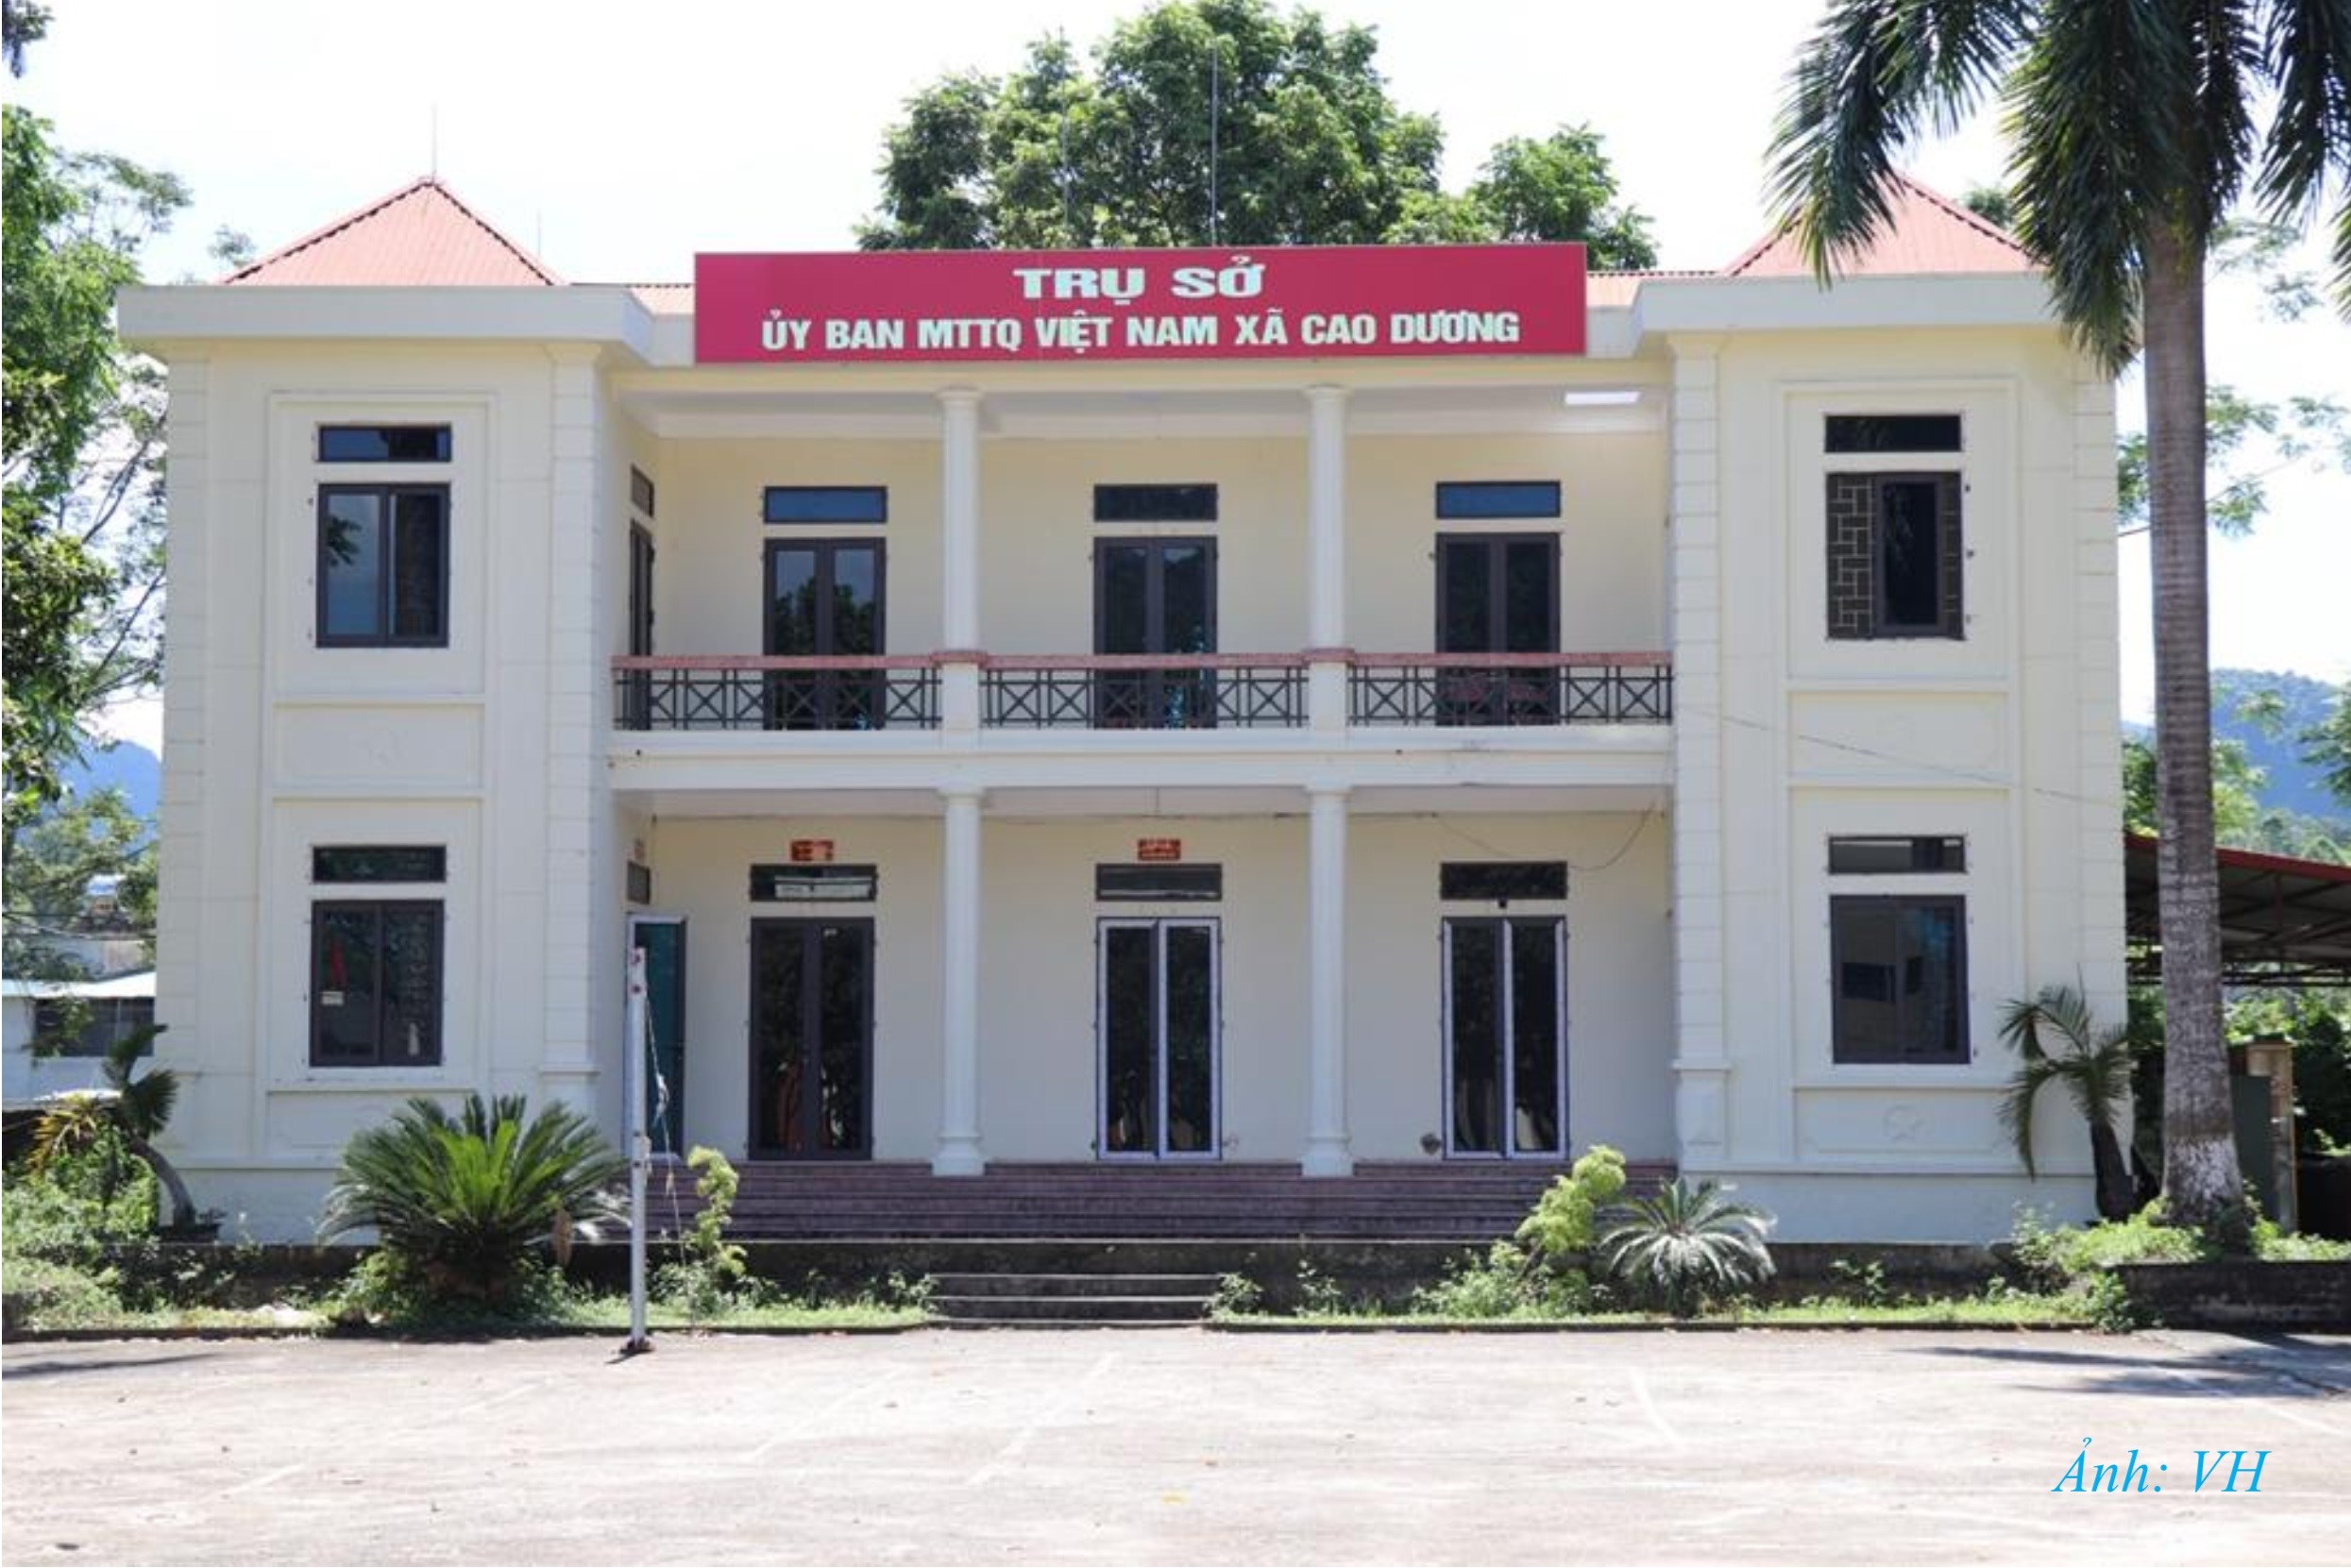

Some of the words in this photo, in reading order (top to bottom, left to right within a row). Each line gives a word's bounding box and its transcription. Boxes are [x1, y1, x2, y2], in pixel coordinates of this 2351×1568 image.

[1012, 267, 1146, 306] TRỤ
[1170, 255, 1266, 299] SỞ
[761, 308, 812, 351] ỦY
[824, 318, 905, 350] BAN
[917, 317, 1023, 352] MTTQ
[1033, 309, 1114, 354] VIỆT
[1125, 315, 1218, 347] NAM
[1234, 307, 1289, 346] XÃ
[1300, 313, 1378, 346] CAO
[1390, 309, 1520, 344] DƯƠNG
